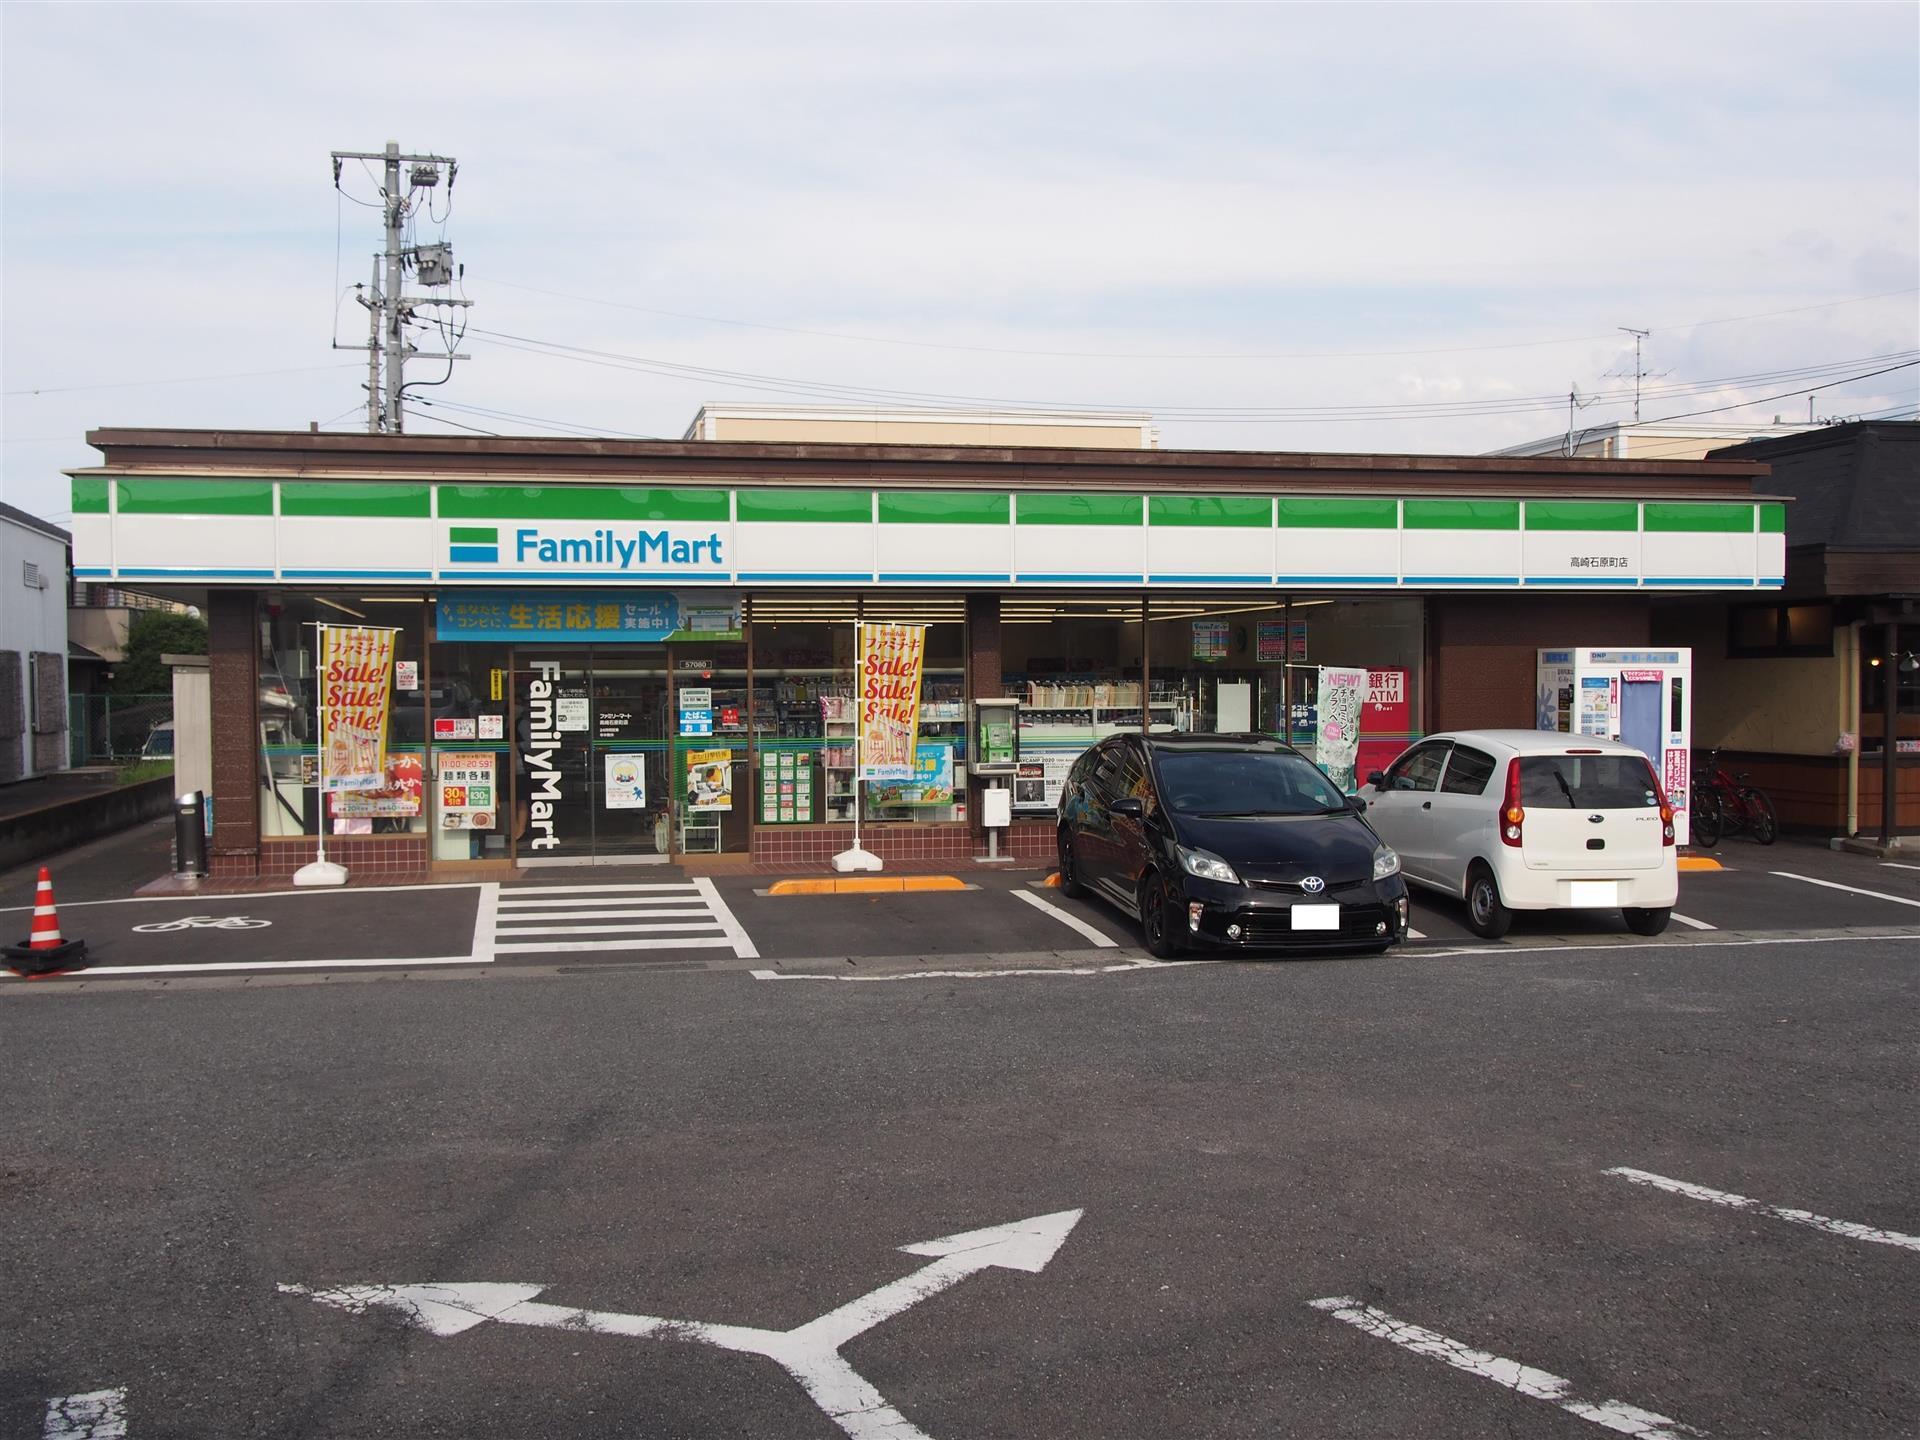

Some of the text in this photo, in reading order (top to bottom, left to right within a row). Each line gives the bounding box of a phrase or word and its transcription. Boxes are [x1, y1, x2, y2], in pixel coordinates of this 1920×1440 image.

[516, 529, 723, 569] FamilyMart
[1570, 556, 1630, 568] 高崎石原町店
[509, 603, 620, 630] 生活応援
[624, 604, 662, 616] セール
[329, 641, 390, 657] ファミチキ
[865, 637, 920, 651] ファミチキ
[327, 659, 389, 683] Sale!
[864, 654, 919, 677] Sale!
[1328, 672, 1361, 687] NEW!
[1368, 673, 1400, 689] 銀行
[326, 684, 386, 707] Sale!
[863, 677, 917, 702] Sale!
[1368, 690, 1399, 702] ATM
[327, 709, 384, 733] Sale!
[685, 711, 708, 720] たばこ
[863, 701, 916, 724] Sale!
[1339, 688, 1348, 739] チョコミント
[524, 661, 562, 850] FamilyMart
[444, 771, 492, 781] 麺類各種
[444, 787, 465, 799] 30円
